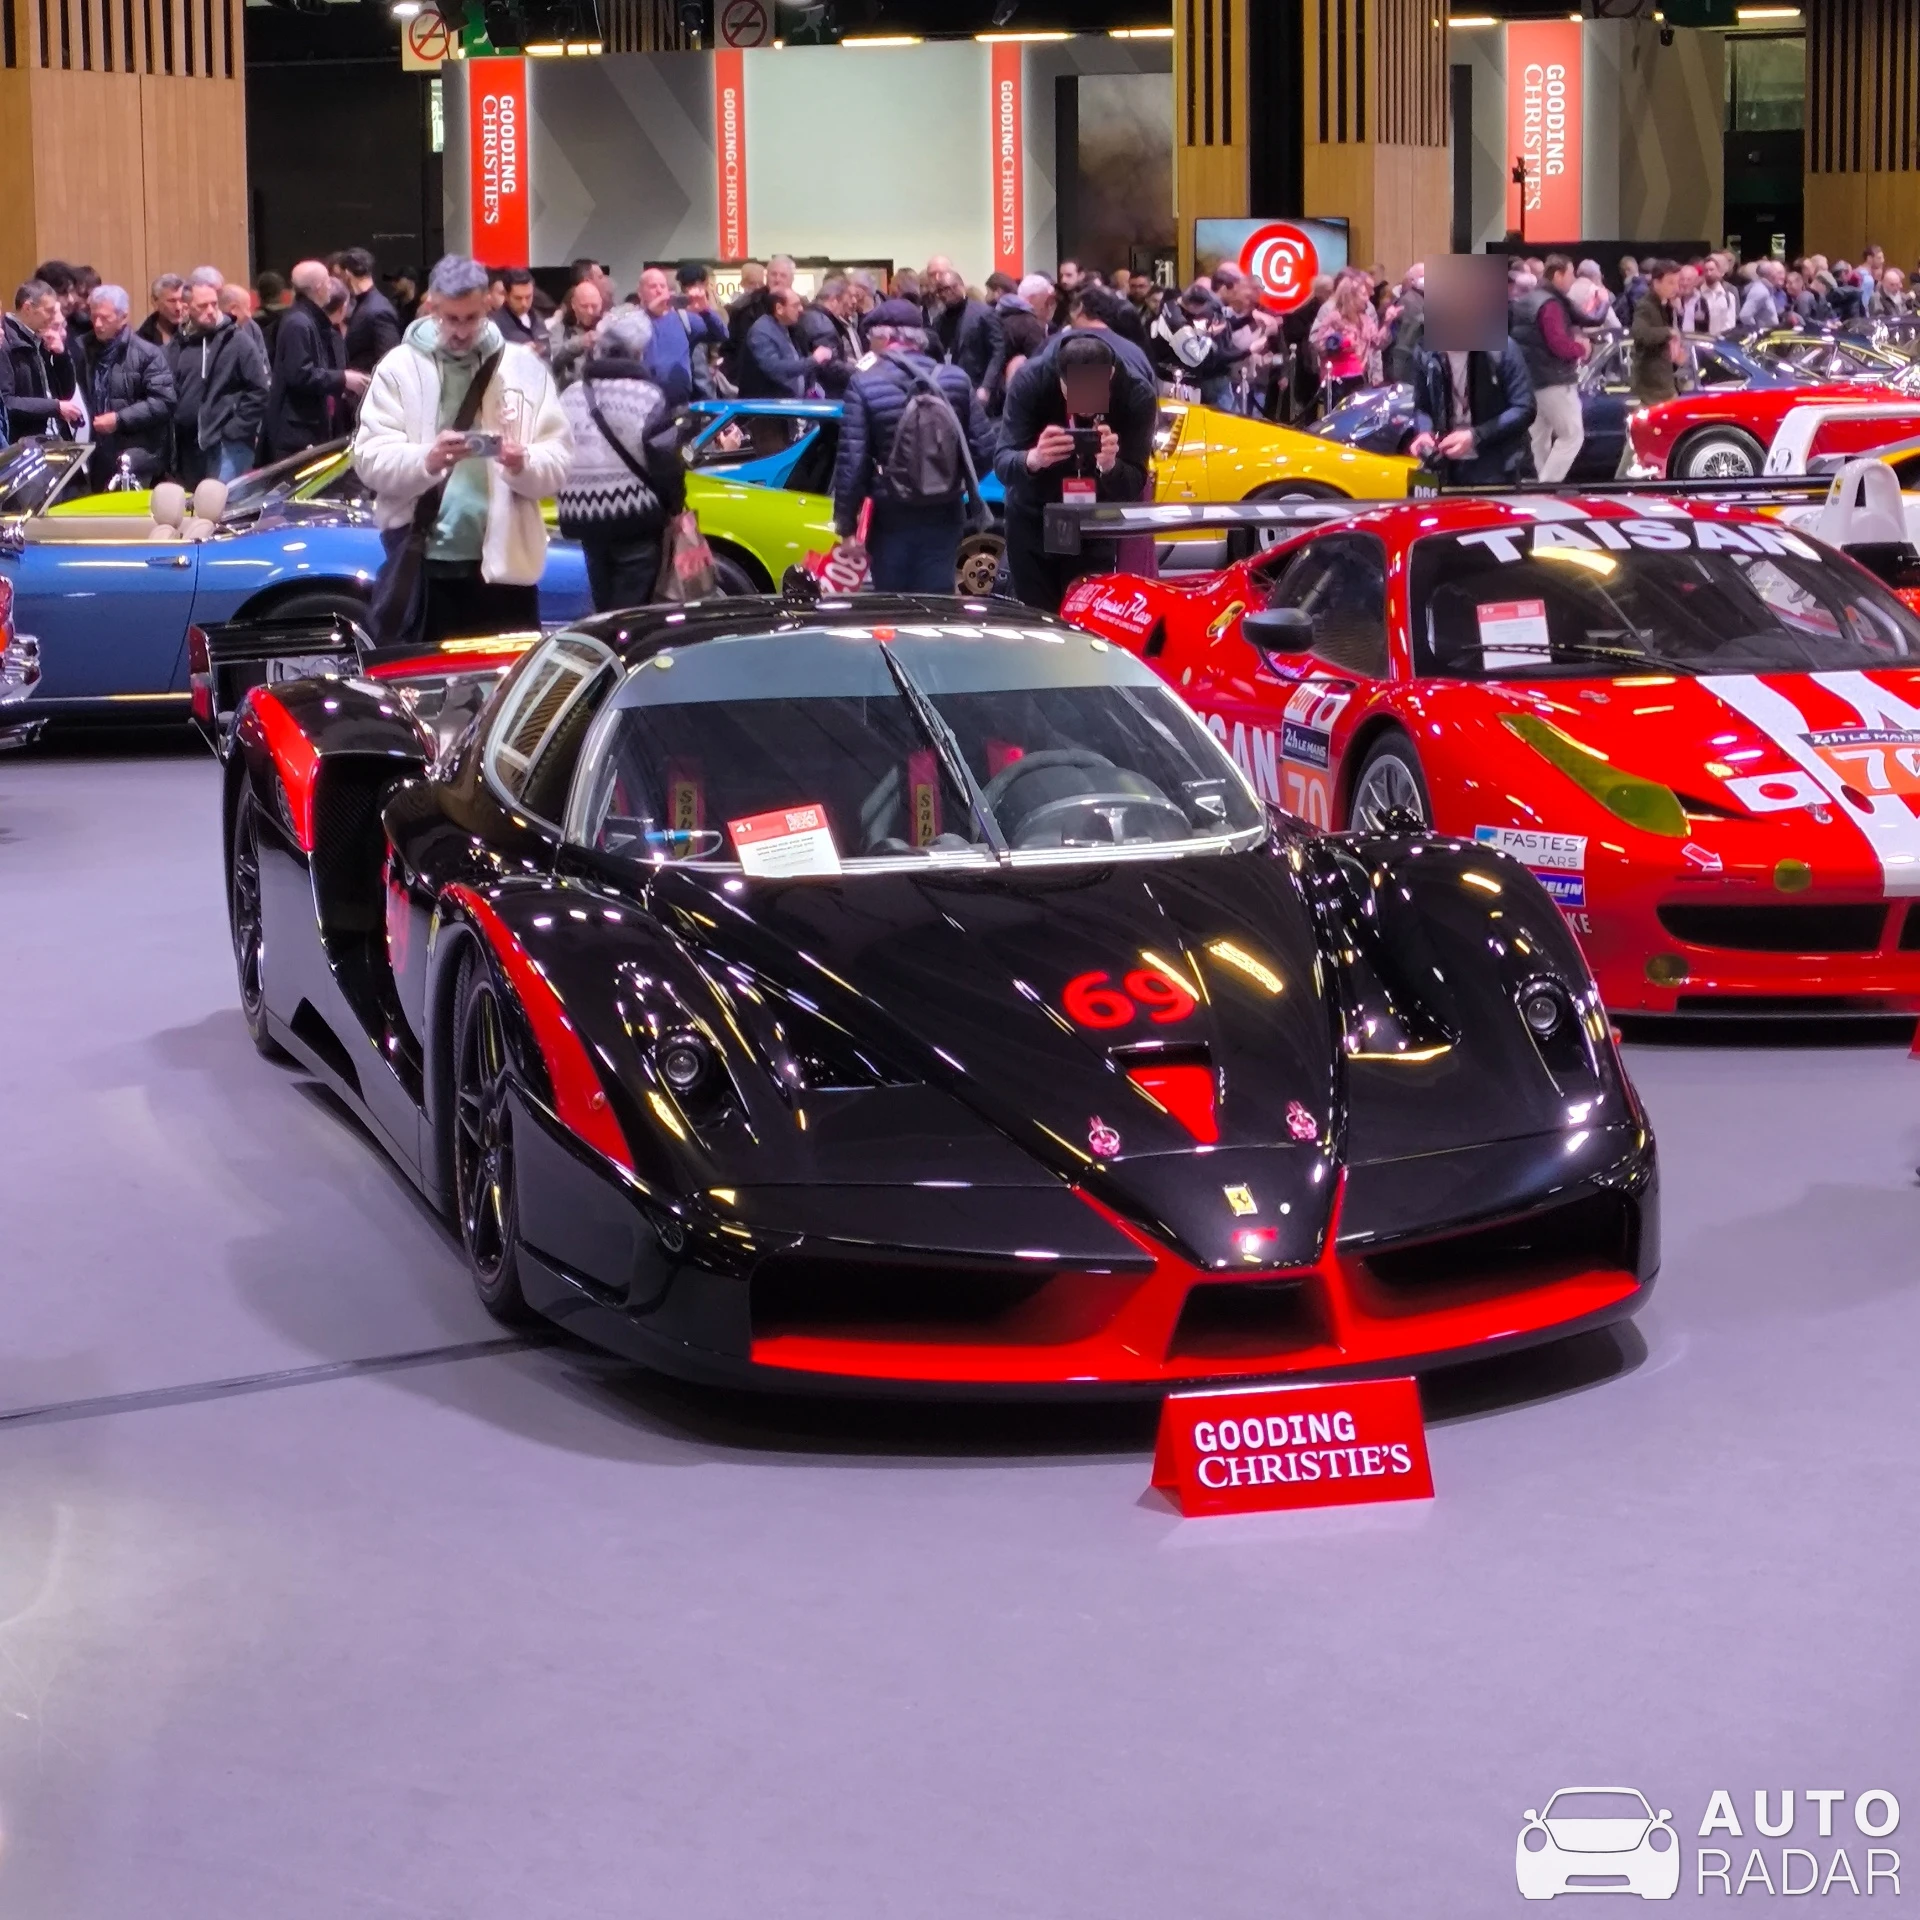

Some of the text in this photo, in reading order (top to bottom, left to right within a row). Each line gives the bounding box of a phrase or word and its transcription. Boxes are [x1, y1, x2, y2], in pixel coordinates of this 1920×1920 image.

[500, 95, 516, 193] GOODING
[724, 88, 737, 161] GOODING
[1001, 80, 1013, 155] GOODING
[1524, 63, 1543, 211] CHRISTIE'S
[1546, 64, 1565, 176] GOODING
[483, 94, 499, 225] CHRISTIE'S
[1456, 519, 1822, 564] TAISAN
[1297, 739, 1307, 752] LE
[1307, 741, 1327, 758] MANS
[1849, 732, 1872, 742] LE
[1287, 771, 1329, 833] 70
[1537, 855, 1578, 867] CARS
[1062, 969, 1197, 1029] 69
[1194, 1411, 1356, 1452] GOODING
[1198, 1443, 1412, 1488] CHRISTIE'S
